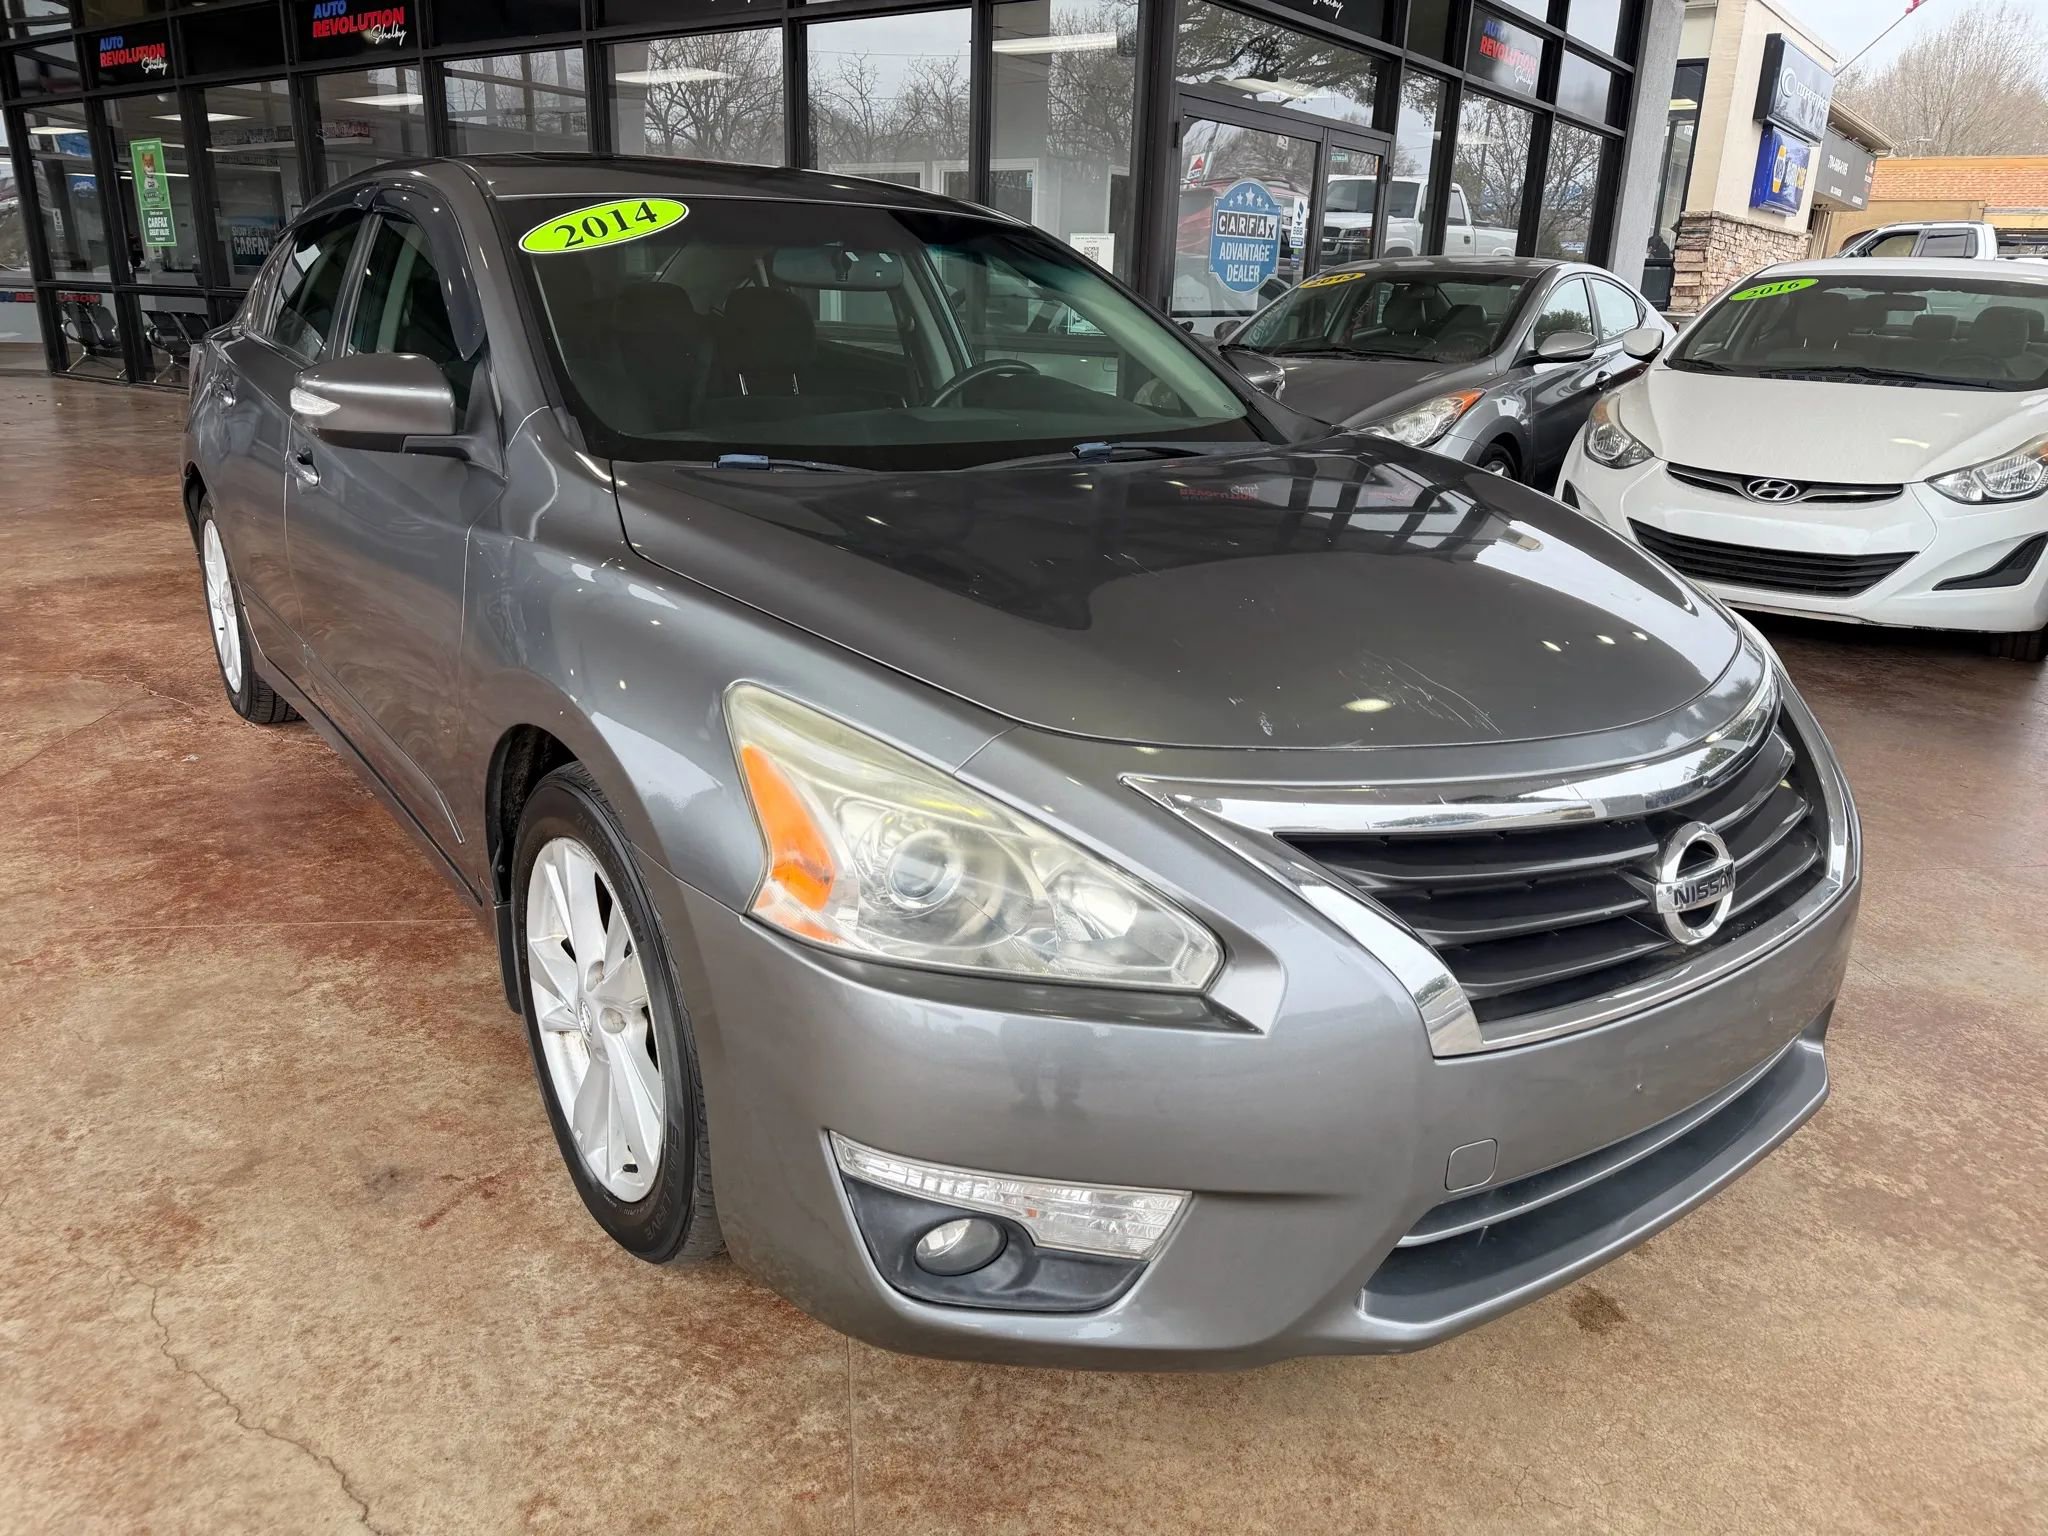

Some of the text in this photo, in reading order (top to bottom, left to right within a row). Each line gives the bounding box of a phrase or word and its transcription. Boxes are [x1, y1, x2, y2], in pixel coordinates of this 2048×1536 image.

[313, 0, 347, 19] AUTO
[312, 6, 405, 38] REVOLUTION
[370, 20, 407, 46] Shelby
[100, 35, 124, 51] AUTO
[100, 43, 166, 68] REVOLUTION
[141, 53, 168, 76] Shelby
[1479, 34, 1537, 77] REVOLUTION
[147, 216, 168, 229] CARFAX
[554, 201, 657, 248] 2014
[1218, 213, 1276, 240] CARFAX
[233, 236, 269, 255] CARFAX
[1219, 242, 1271, 262] ADVANTAGE
[1226, 264, 1260, 283] DEALER
[1746, 282, 1800, 298] 2016
[1673, 863, 1735, 906] NISSAN
